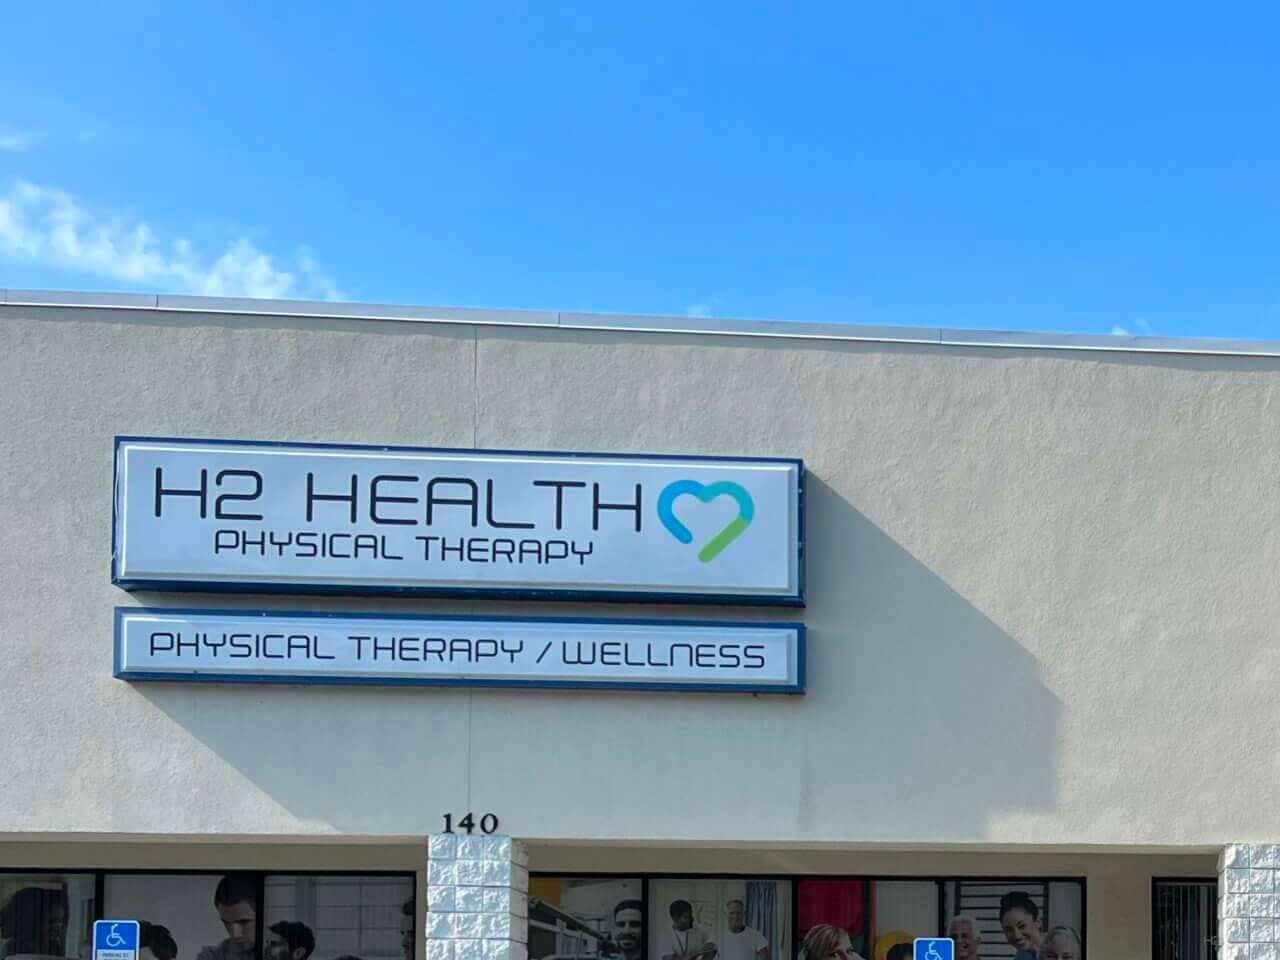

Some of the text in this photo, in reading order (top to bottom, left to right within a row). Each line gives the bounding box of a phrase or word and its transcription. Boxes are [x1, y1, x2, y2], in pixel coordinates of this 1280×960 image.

[154, 467, 643, 533] H2 HEALTH
[214, 529, 594, 566] PHYSICAL THERAPY
[149, 631, 336, 660] PHYSICAL
[347, 636, 524, 664] THERAPY
[562, 641, 766, 669] WELLNESS
[442, 812, 498, 835] 140
